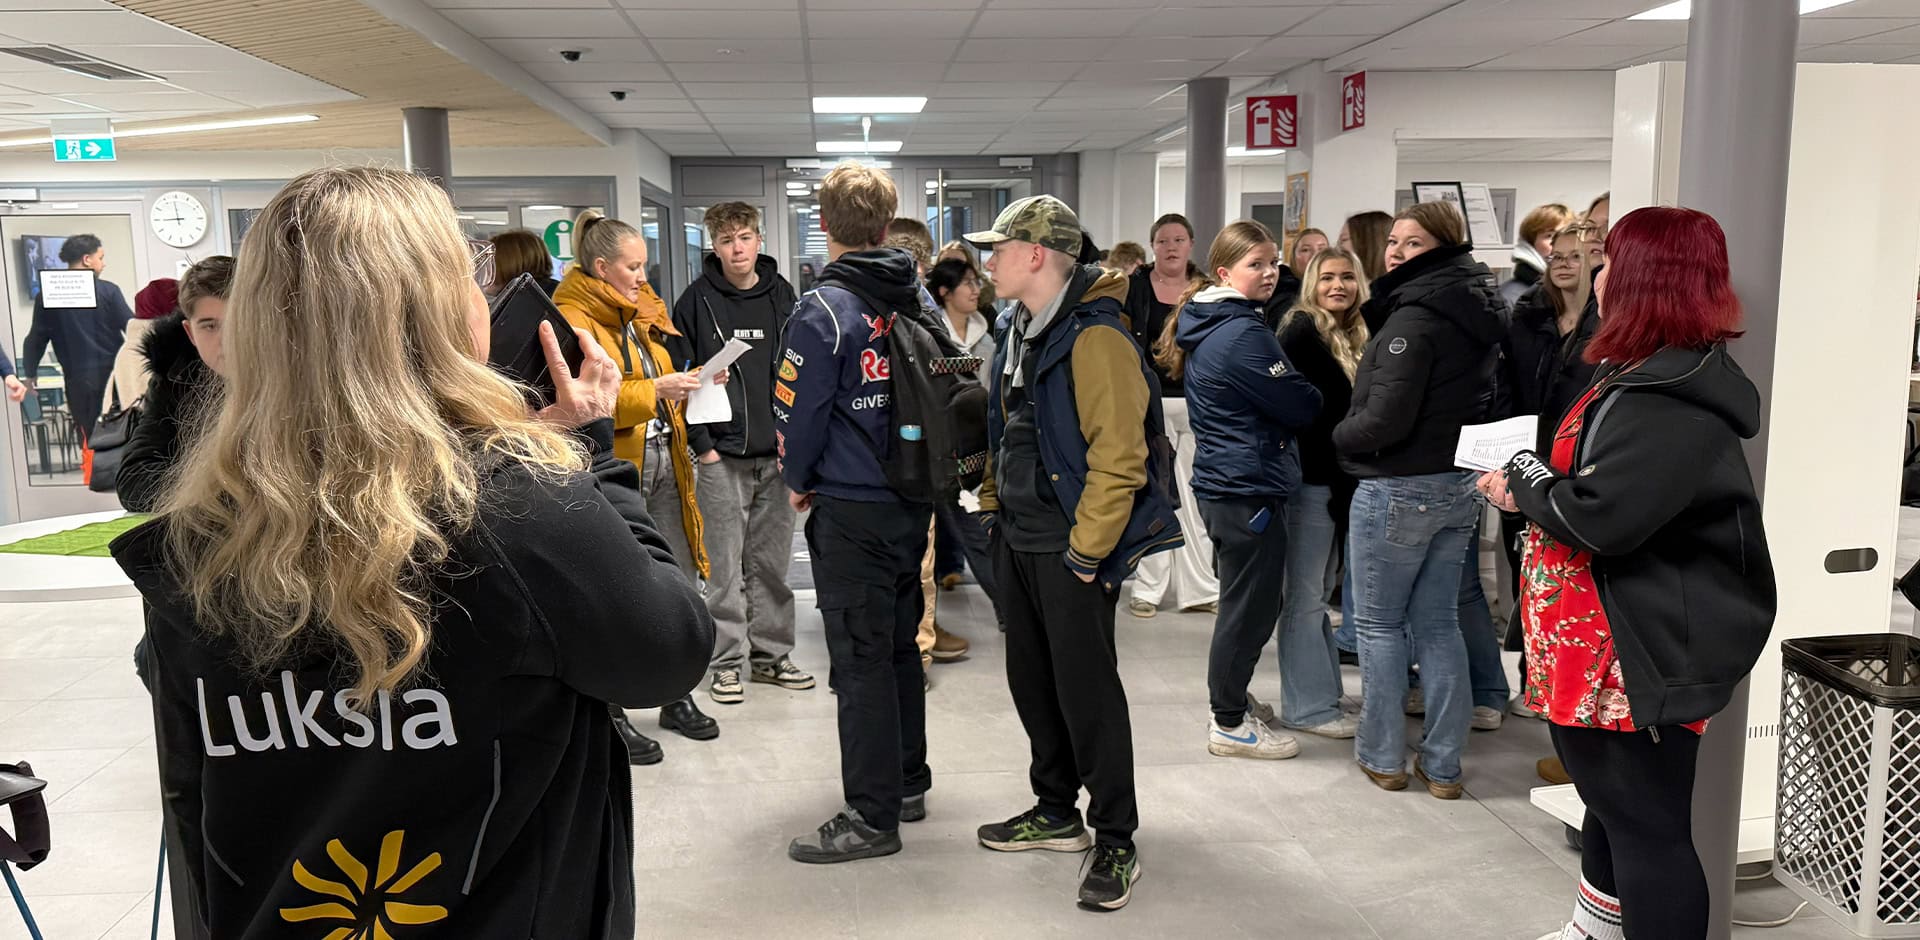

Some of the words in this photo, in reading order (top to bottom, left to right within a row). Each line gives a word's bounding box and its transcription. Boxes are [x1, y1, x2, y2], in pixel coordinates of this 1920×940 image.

[860, 348, 890, 385] Re
[1513, 452, 1554, 488] Luksia
[197, 670, 458, 757] Luksia
